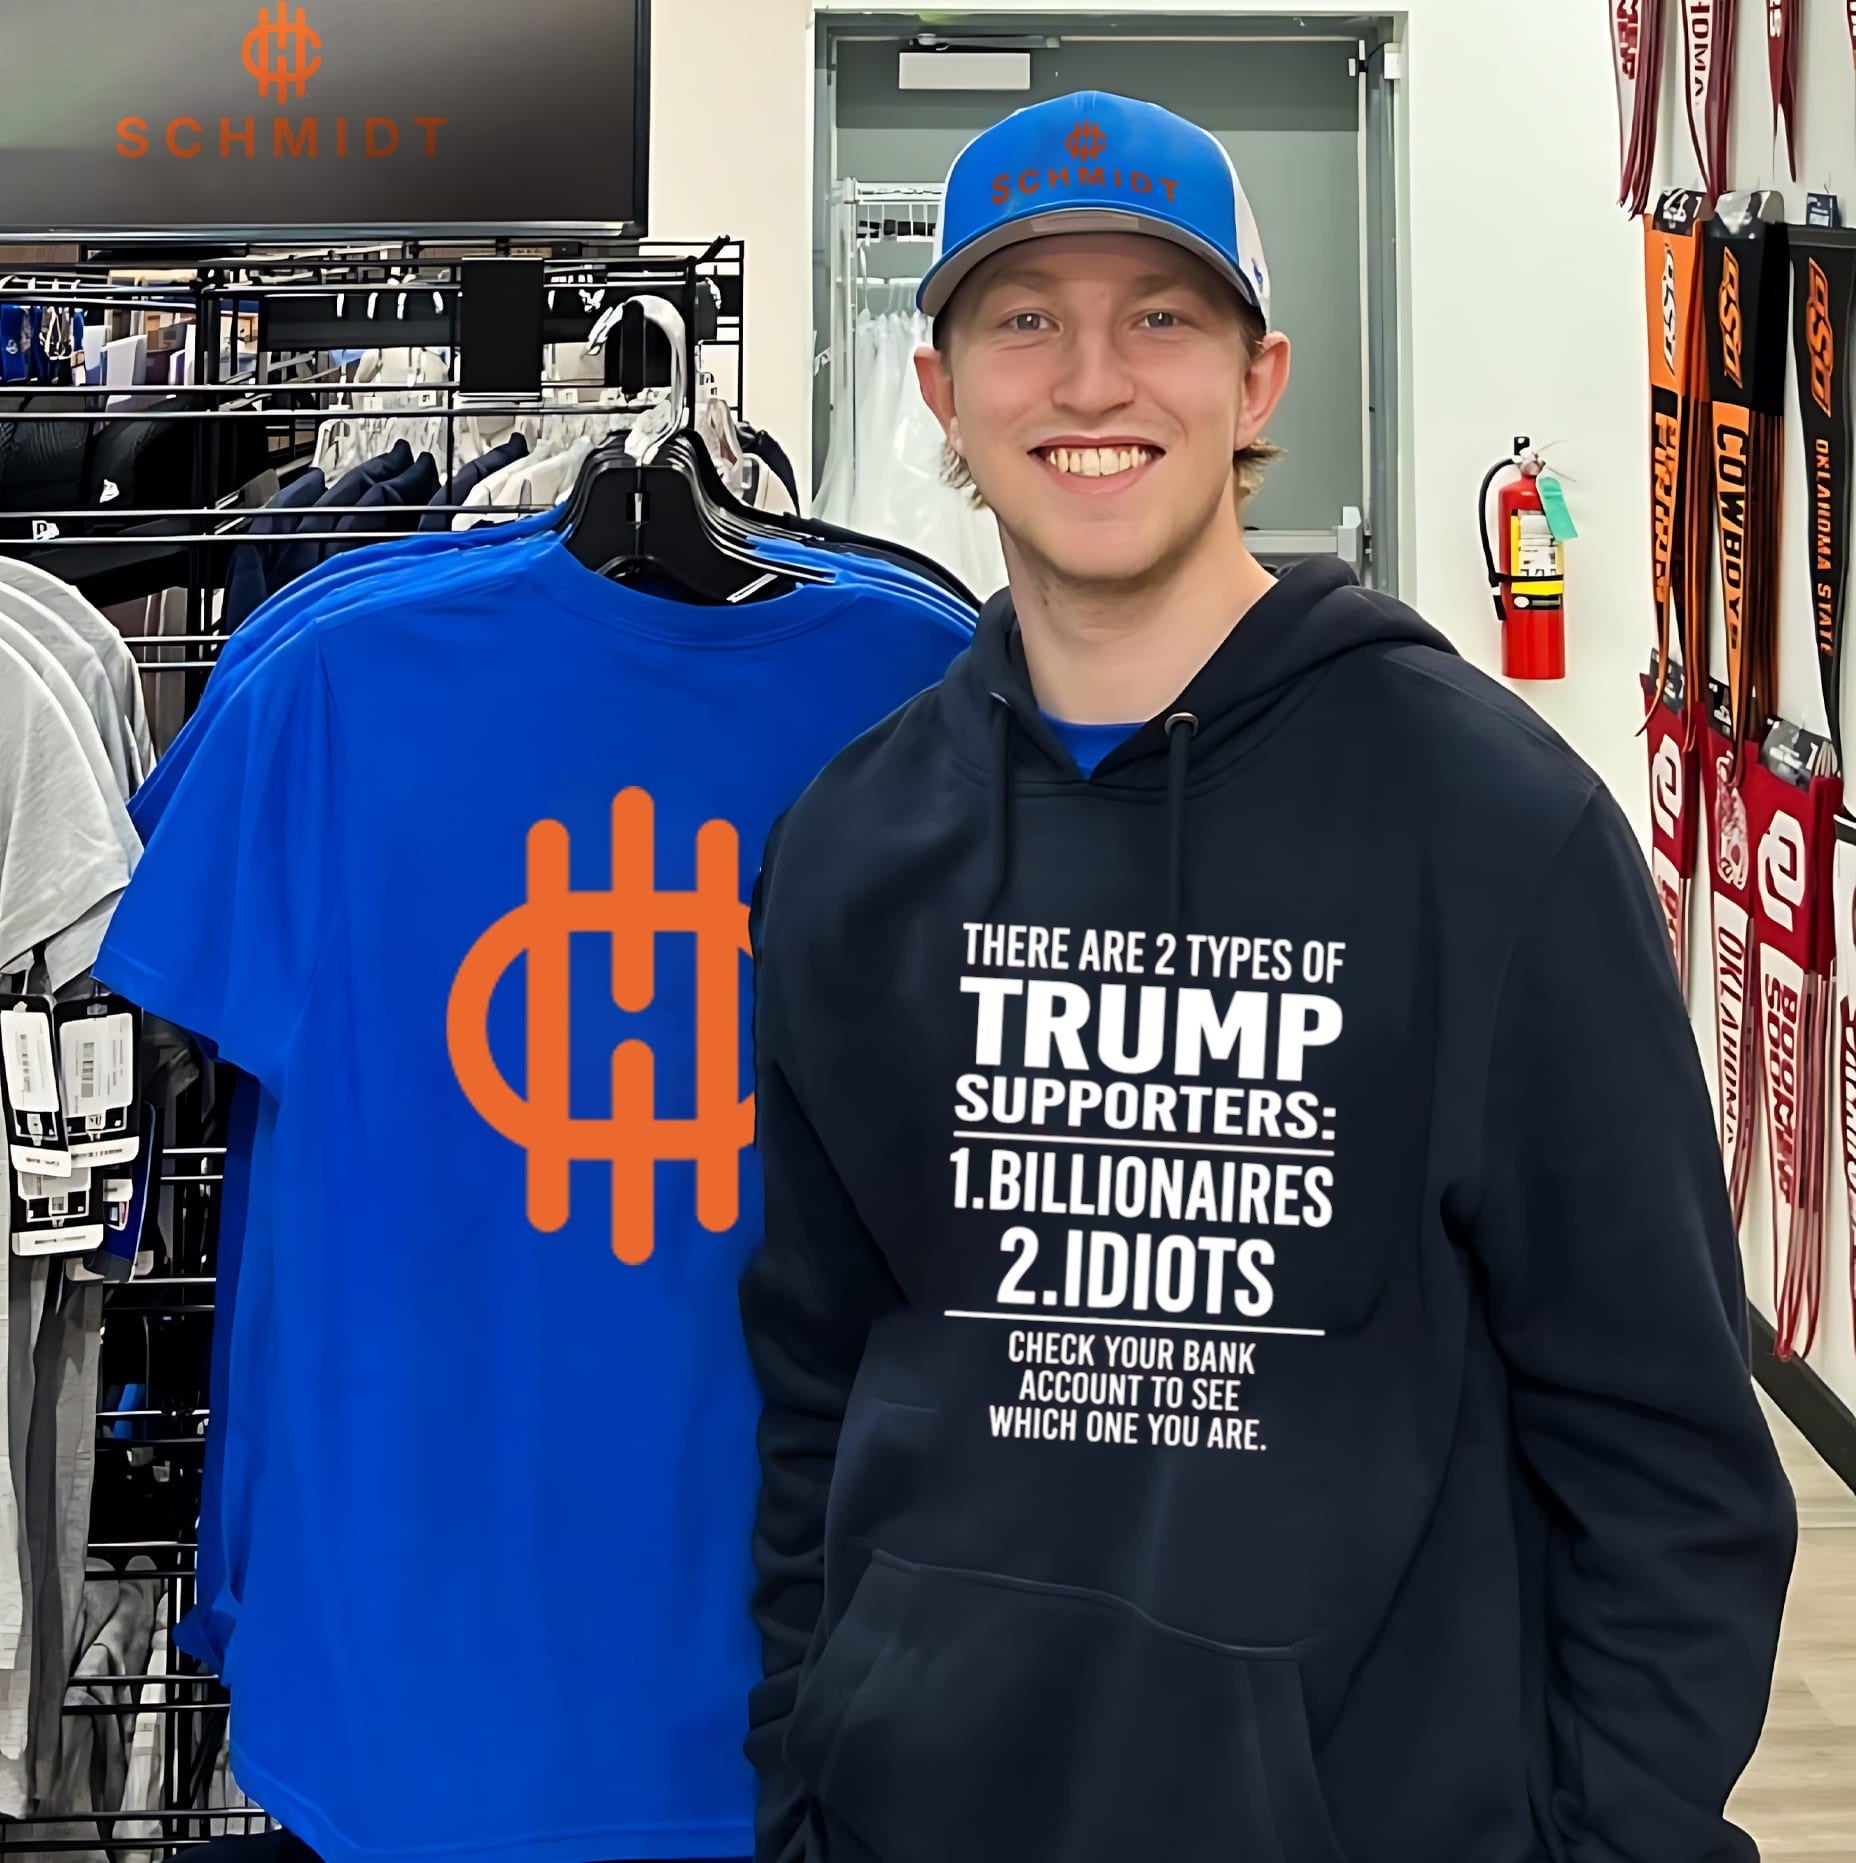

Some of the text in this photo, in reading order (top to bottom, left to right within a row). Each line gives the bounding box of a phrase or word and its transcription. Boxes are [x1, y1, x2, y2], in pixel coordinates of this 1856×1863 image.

[116, 117, 447, 158] SCHMIDT
[992, 166, 1179, 205] SCHMIDT
[963, 922, 1346, 984] THERE ARE 2 TYPES OF
[959, 975, 1343, 1082] TRUMP
[1717, 925, 1745, 1144] OKLAHOMA
[954, 1073, 1337, 1141] SUPPORTERS:
[1008, 1330, 1256, 1375] CHECK YOUR BANK
[1018, 1368, 1241, 1412] ACCOUNT TO SEE
[989, 1404, 1267, 1451] WHICH ONE YOU ARE.
